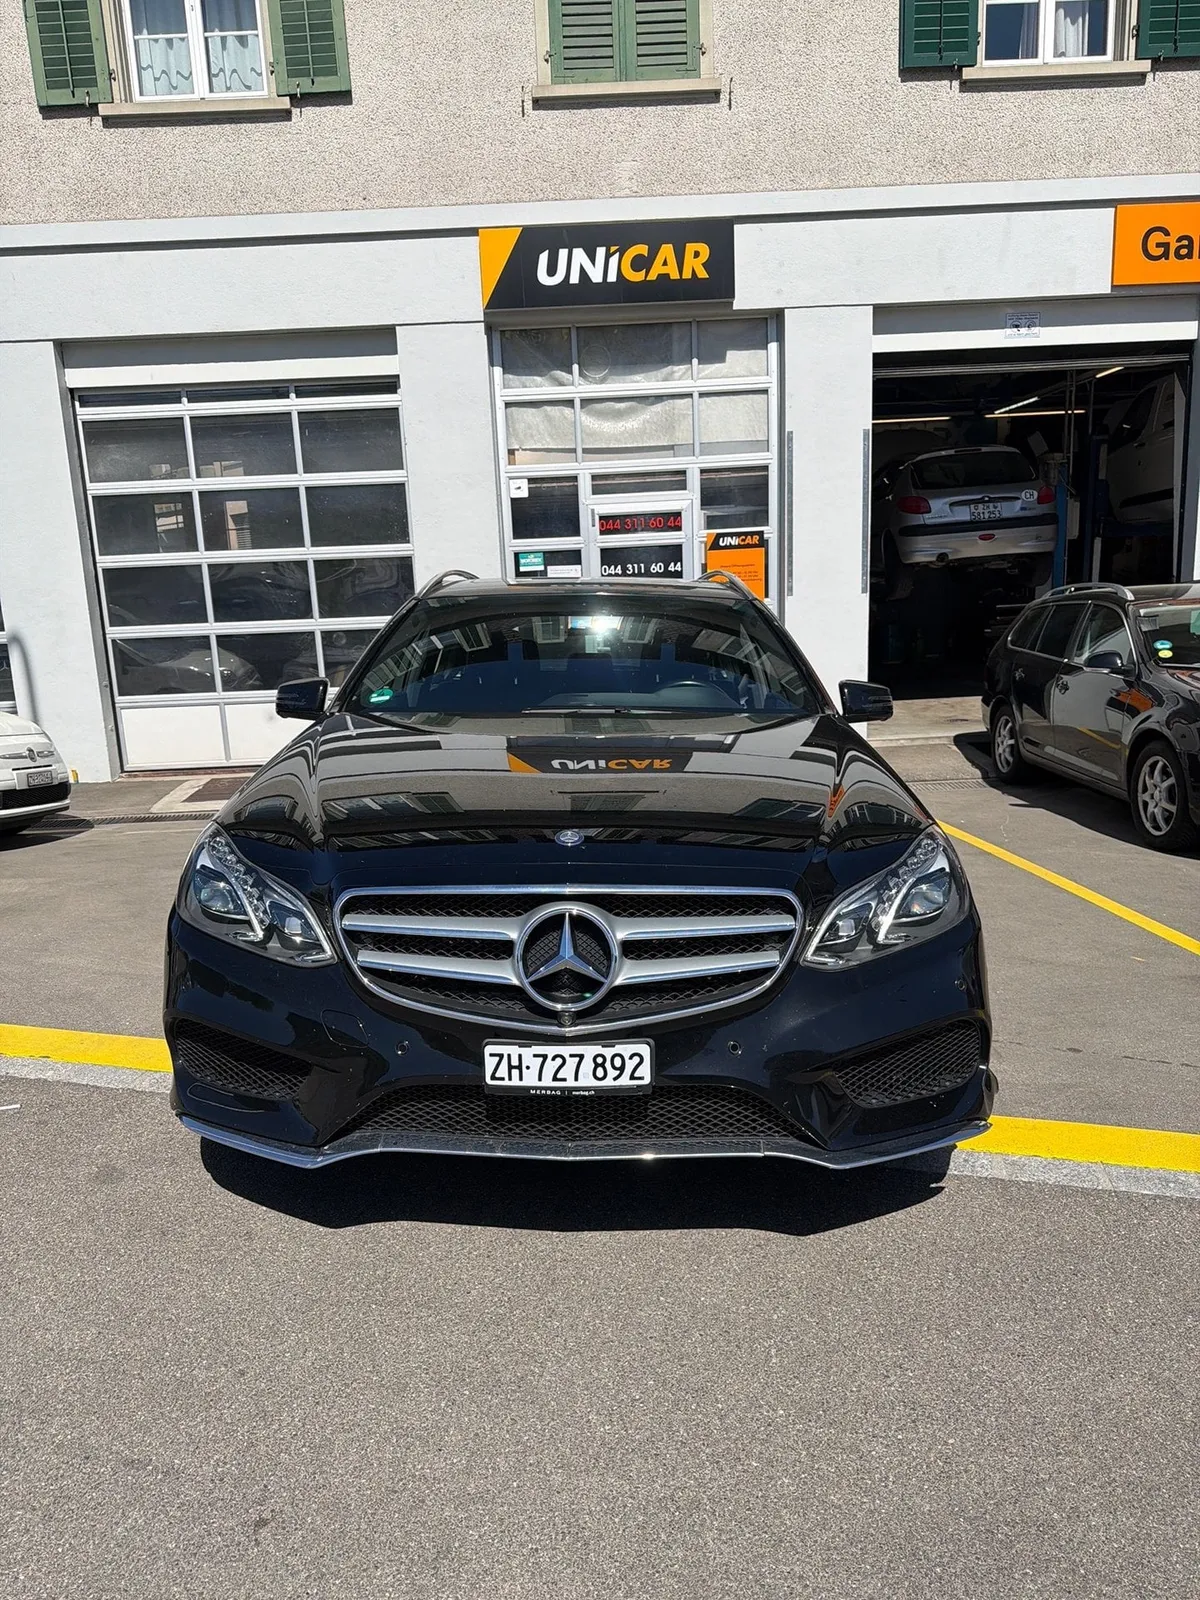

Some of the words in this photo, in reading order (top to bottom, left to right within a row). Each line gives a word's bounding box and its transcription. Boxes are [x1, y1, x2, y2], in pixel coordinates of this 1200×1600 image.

[1141, 225, 1200, 262] Ga
[1024, 491, 1035, 500] CH
[600, 519, 621, 531] 044
[624, 517, 645, 529] 311
[649, 517, 664, 528] 60
[667, 516, 681, 527] 44
[601, 564, 622, 576] 044
[626, 563, 645, 575] 311
[650, 562, 664, 573] 60
[668, 561, 682, 572] 44
